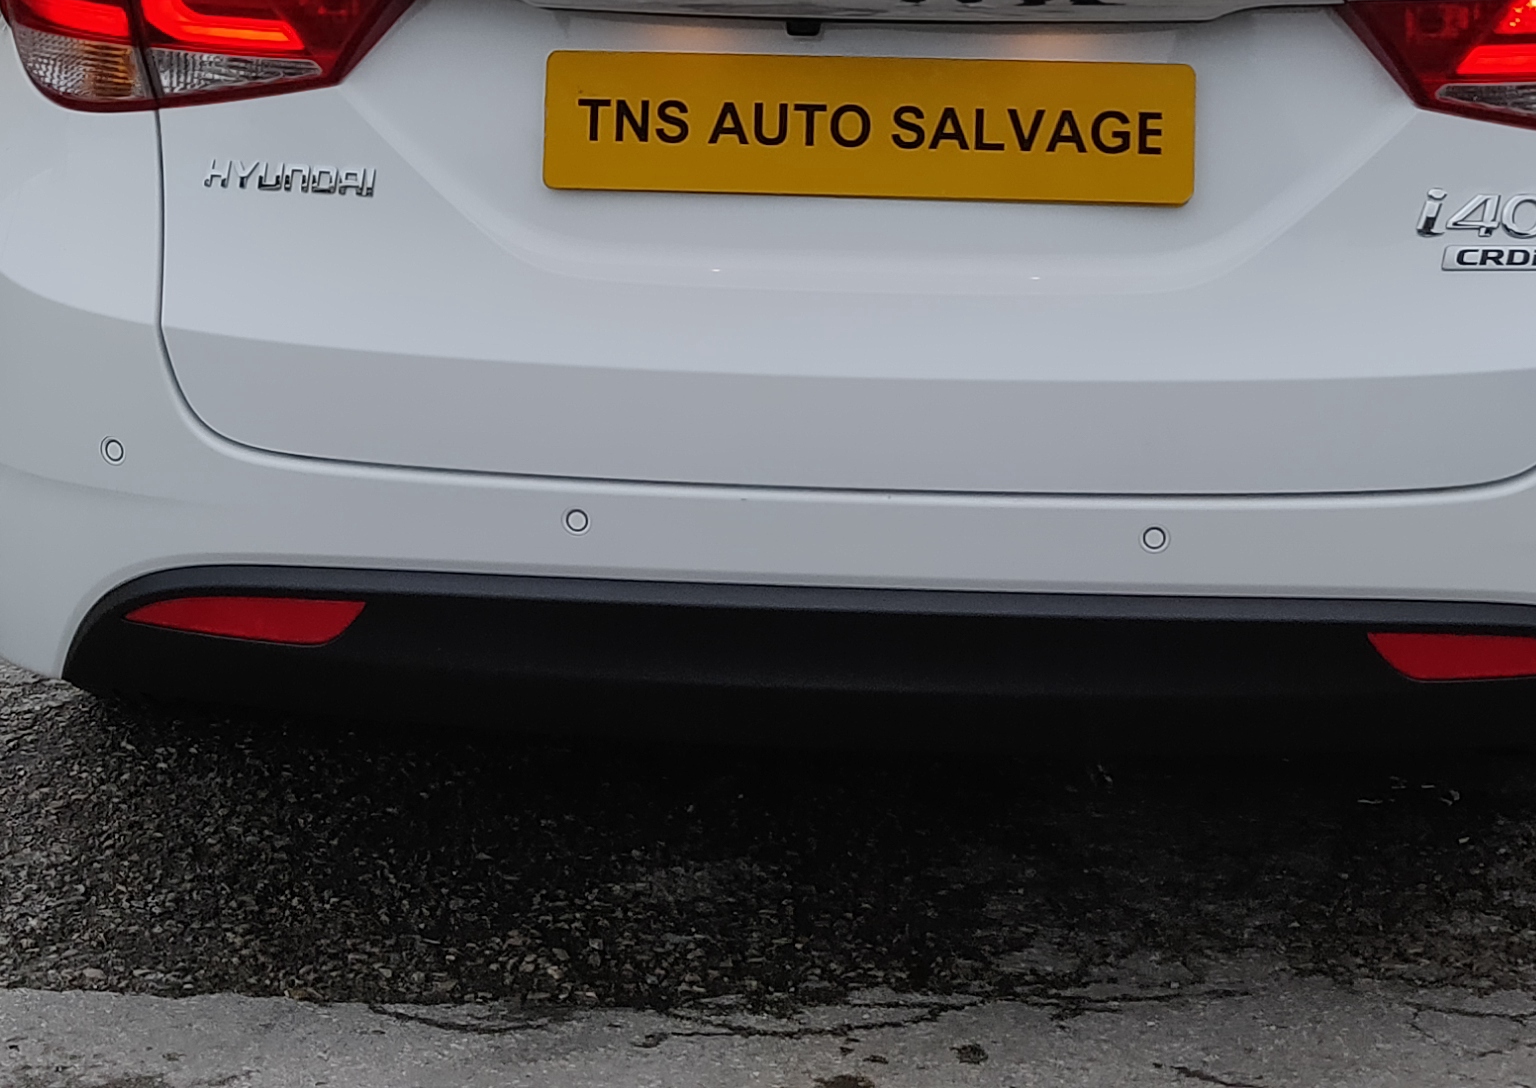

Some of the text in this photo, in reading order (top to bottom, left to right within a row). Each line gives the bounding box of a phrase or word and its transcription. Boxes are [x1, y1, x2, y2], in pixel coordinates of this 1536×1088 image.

[577, 97, 1164, 156] TNS AUTO SALVAGE
[203, 158, 377, 198] HYUNDAI
